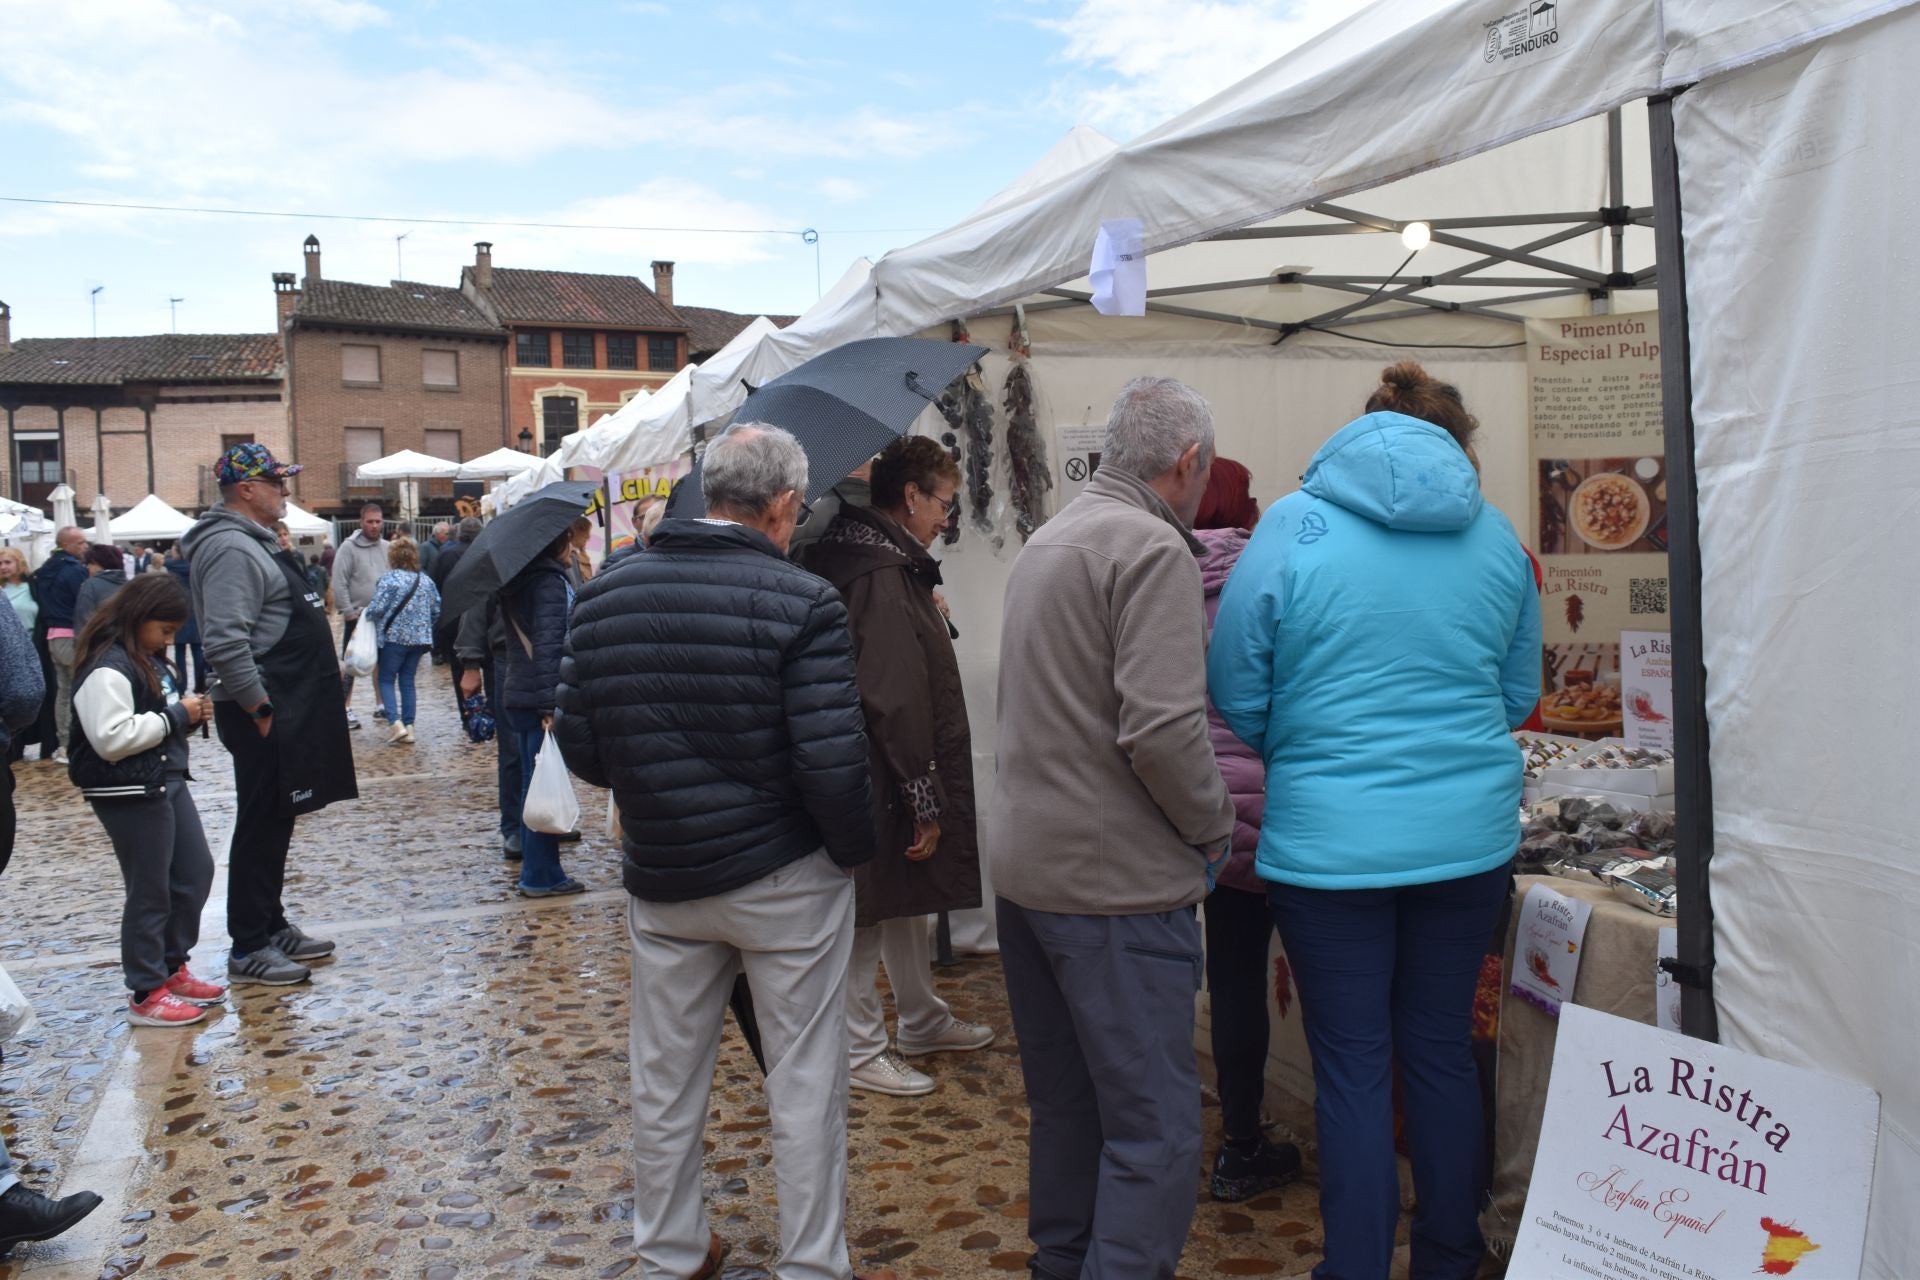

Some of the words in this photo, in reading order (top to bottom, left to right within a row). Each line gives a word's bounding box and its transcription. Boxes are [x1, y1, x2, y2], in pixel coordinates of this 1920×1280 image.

[1514, 31, 1559, 56] ENDURO
[1561, 319, 1646, 338] Pimentón
[1540, 344, 1611, 365] Especial
[1618, 341, 1660, 361] Pulp
[1639, 381, 1661, 390] añad
[1566, 396, 1582, 404] que
[1620, 392, 1656, 402] picante
[1548, 566, 1602, 578] Pimentón
[1543, 581, 1562, 596] La
[1566, 578, 1609, 596] Ristra
[1630, 645, 1647, 658] La
[1650, 639, 1672, 654] Ris
[1536, 910, 1568, 932] Azafrán
[1538, 899, 1549, 908] La
[1550, 900, 1574, 922] Ristra
[1600, 1060, 1654, 1098] La
[1667, 1057, 1791, 1154] Ristra
[1601, 1103, 1768, 1196] Azafrán
[1536, 1216, 1562, 1234] Cuando
[1563, 1227, 1580, 1242] haya
[1580, 1234, 1608, 1253] hervido
[1610, 1247, 1615, 1256] 2
[1650, 1264, 1658, 1274] lo
[1553, 1210, 1584, 1230] Ponemos
[1588, 1224, 1593, 1233] 3
[1604, 1232, 1610, 1240] 4
[1614, 1235, 1638, 1252] hebras
[1640, 1246, 1648, 1257] de
[1682, 1264, 1692, 1276] La
[1562, 1254, 1572, 1265] La
[1602, 1257, 1612, 1269] las
[1614, 1262, 1638, 1280] hebras
